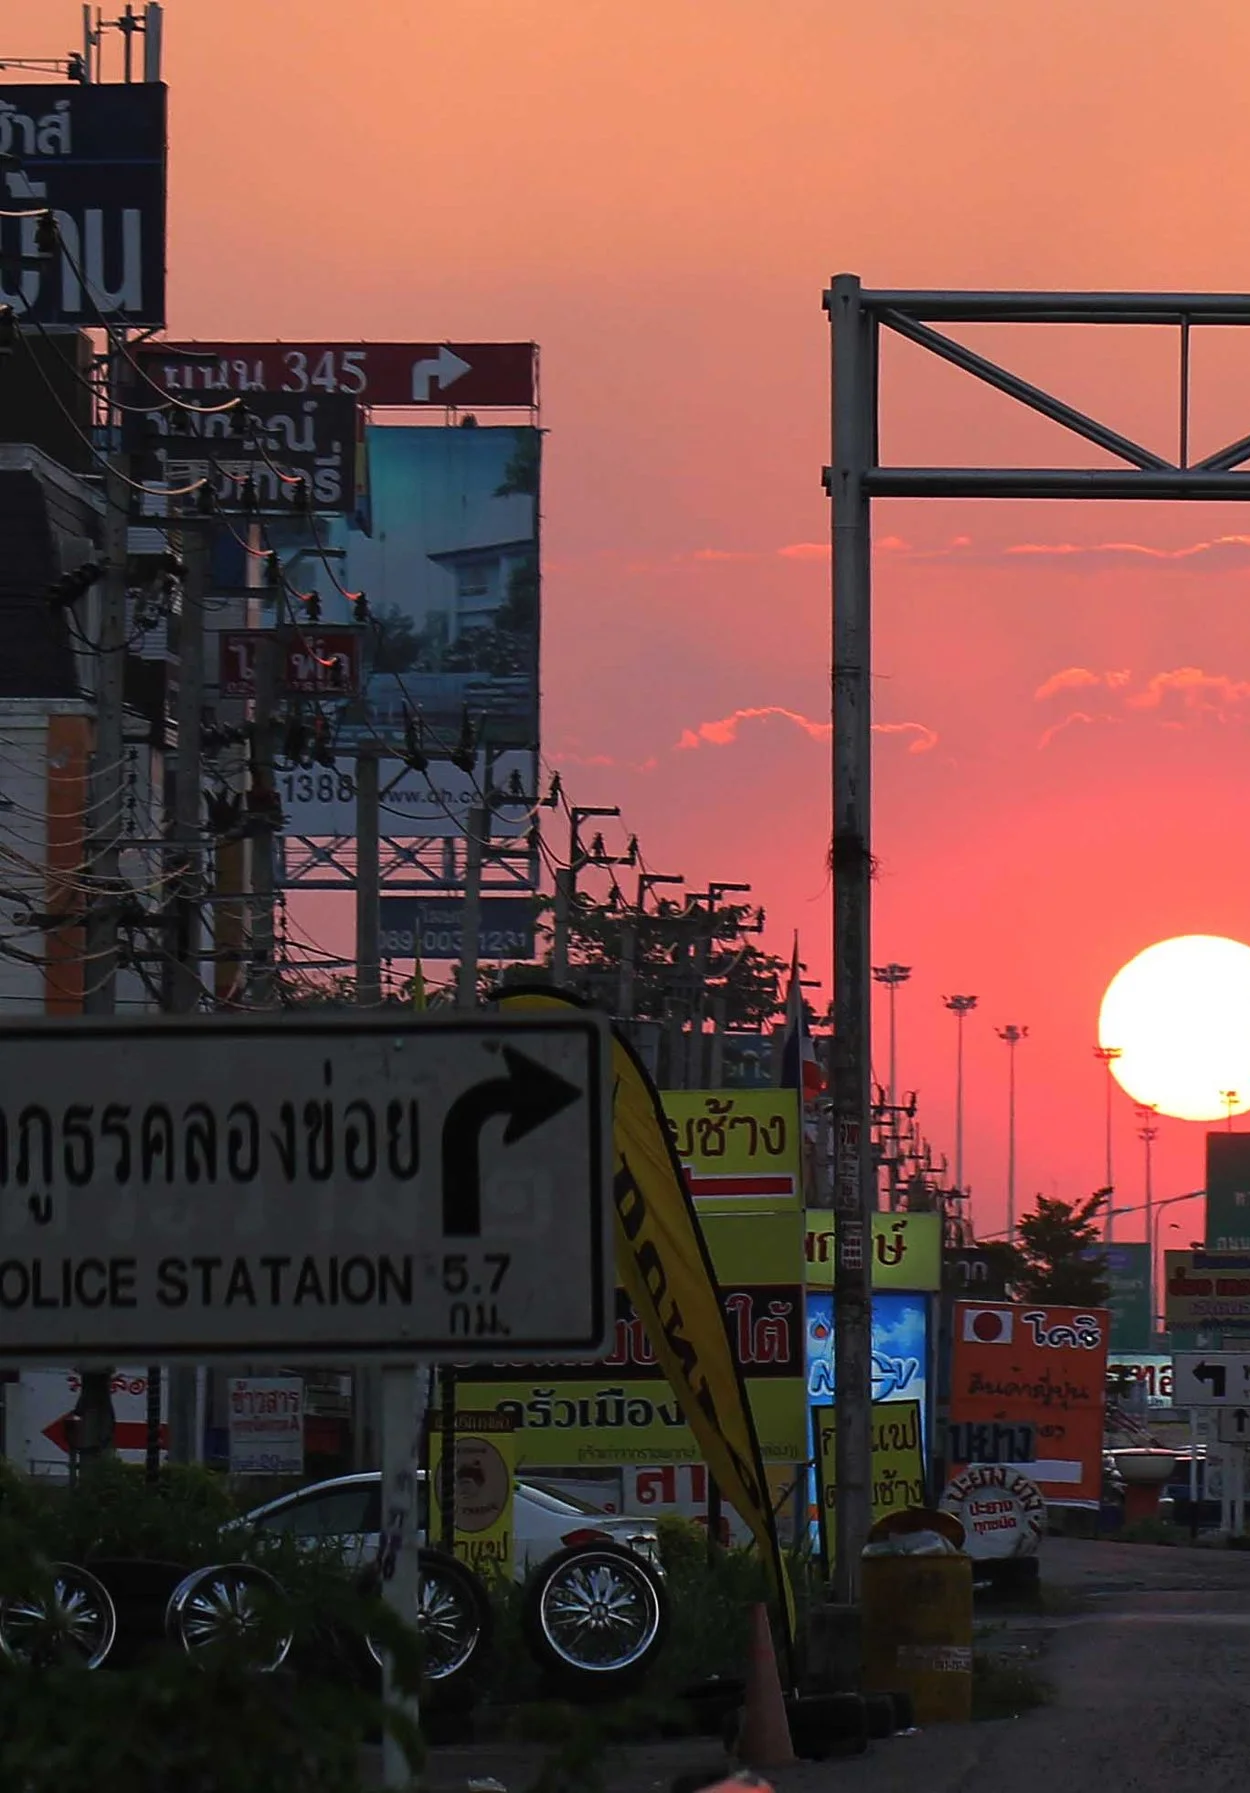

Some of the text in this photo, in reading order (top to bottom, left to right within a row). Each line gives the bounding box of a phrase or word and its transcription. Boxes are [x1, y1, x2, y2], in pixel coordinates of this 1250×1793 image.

[281, 350, 367, 395] 345
[284, 773, 352, 801] 1388
[0, 1058, 420, 1226] ภูธรคลองข่อย
[0, 1255, 412, 1310] OLICE STATAION
[442, 1253, 511, 1295] 5.7
[449, 1303, 512, 1336] กม.
